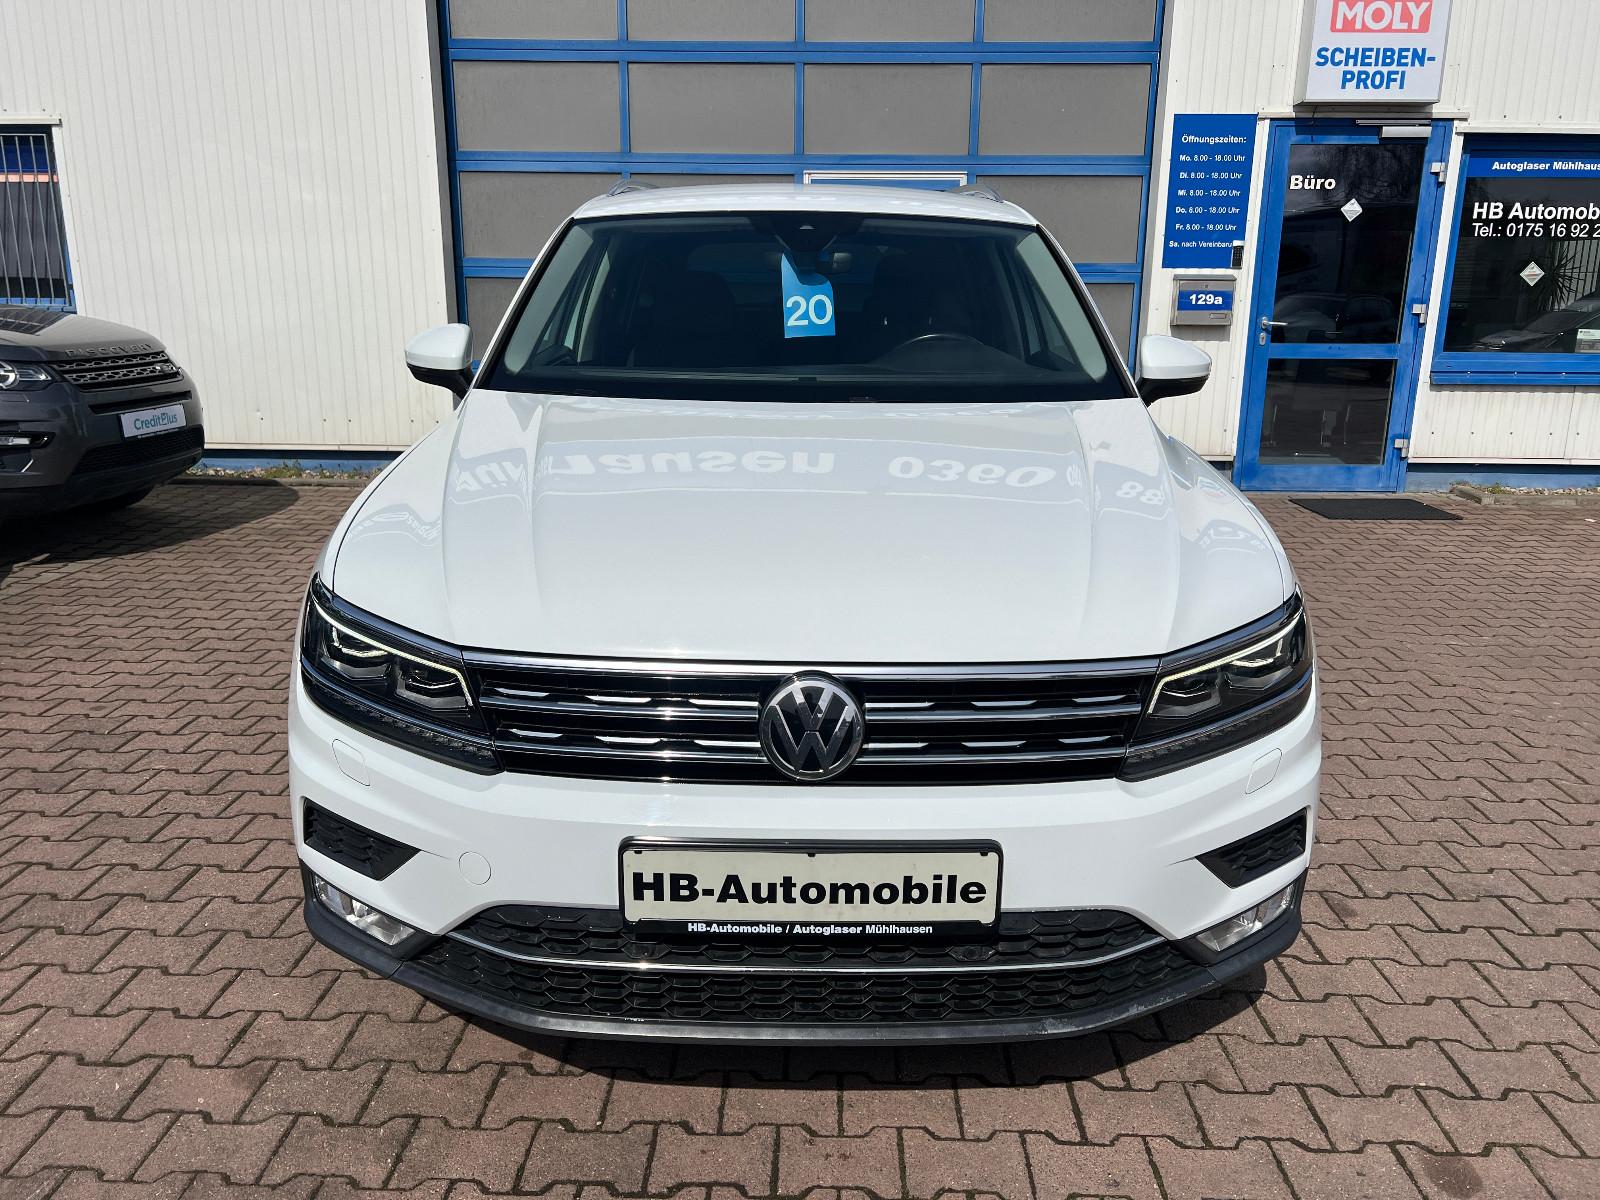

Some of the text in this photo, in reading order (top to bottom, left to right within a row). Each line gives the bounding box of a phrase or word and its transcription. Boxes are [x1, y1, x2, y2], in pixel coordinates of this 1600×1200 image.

[1335, 1, 1430, 30] MOLY
[1315, 47, 1437, 67] SCHEIBEN-
[1341, 70, 1406, 89] PROFI
[1181, 133, 1247, 145] Öffnungszeiten:
[1492, 161, 1550, 172] Autoglaser
[1289, 174, 1336, 191] Büro
[1177, 189, 1187, 197] Mi.
[1228, 189, 1240, 197] Uhr
[1175, 206, 1187, 214] Do.
[1227, 206, 1240, 214] Uhr
[1472, 202, 1600, 220] HB Automob
[1472, 222, 1502, 237] Tel.:
[1506, 222, 1544, 237] 0175
[1549, 223, 1567, 237] 16
[1570, 223, 1590, 238] 92
[1168, 240, 1180, 248] Sa.
[1181, 240, 1197, 248] nach
[1189, 293, 1223, 305] 129a
[786, 294, 832, 326] 20
[133, 412, 178, 430] CreditPlus
[632, 872, 988, 905] HB-Automobile
[687, 922, 782, 934] HB-Automobile
[793, 923, 862, 936] Autoglaser
[865, 923, 933, 935] Mühlhausen
